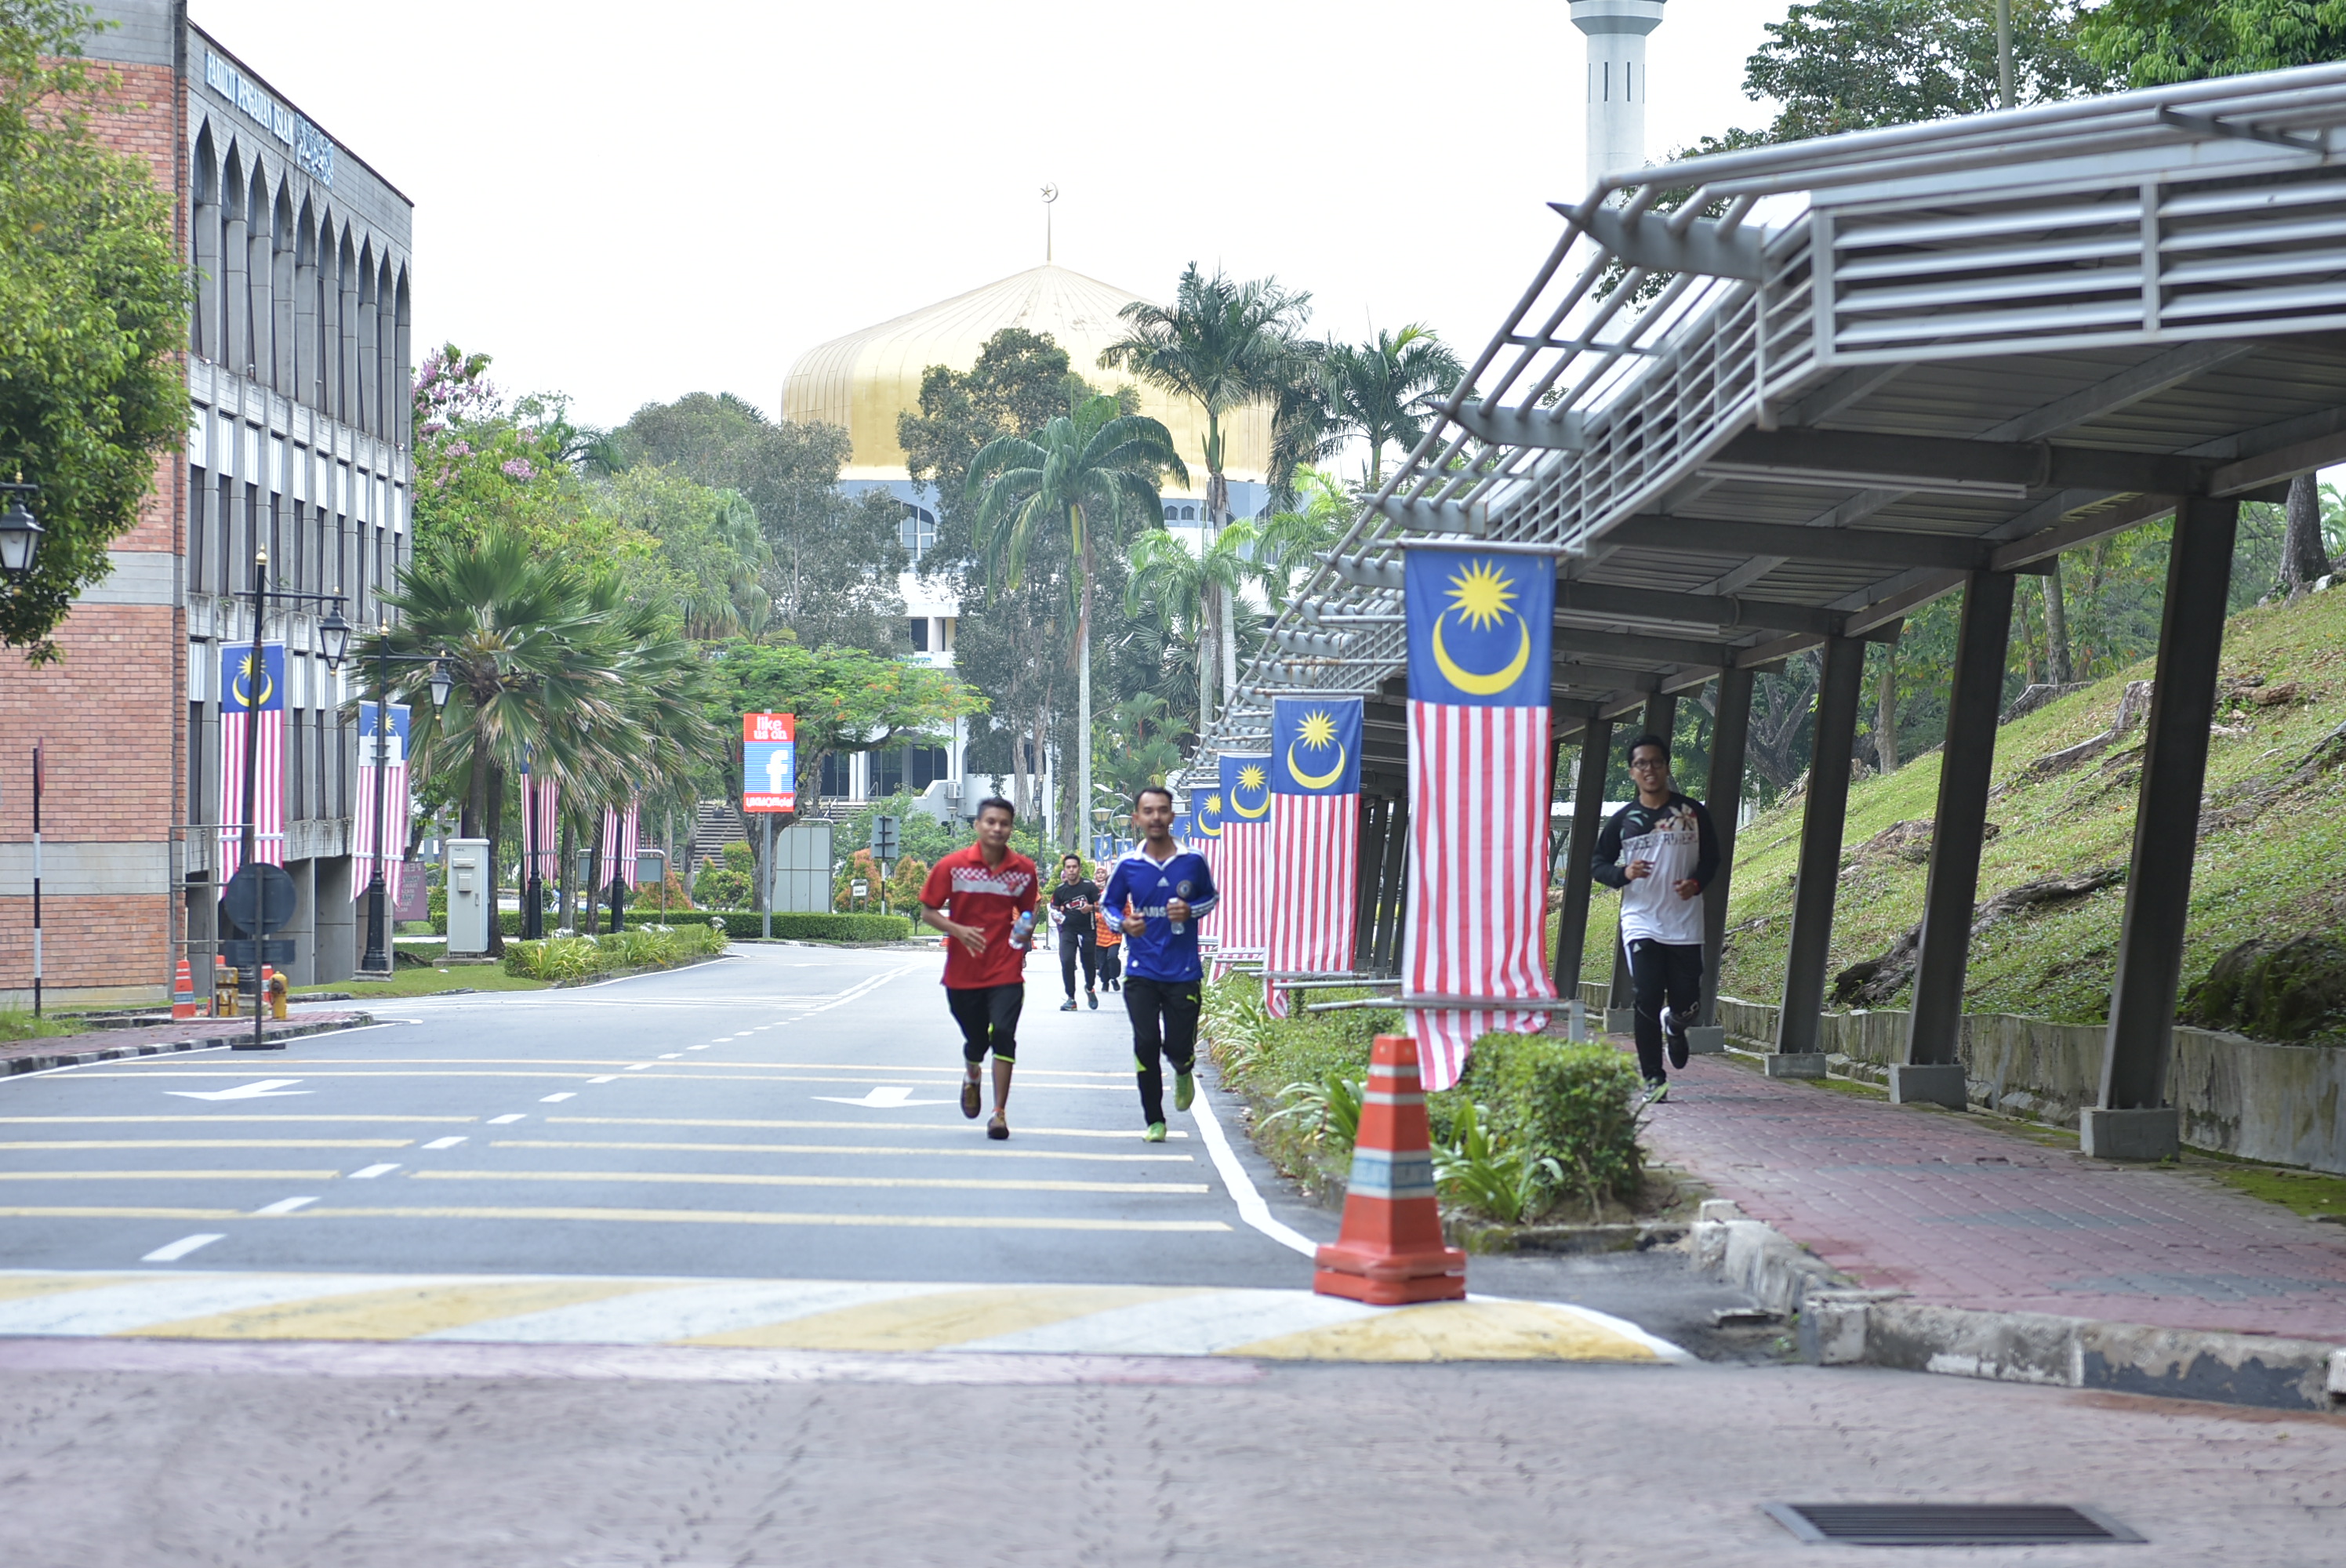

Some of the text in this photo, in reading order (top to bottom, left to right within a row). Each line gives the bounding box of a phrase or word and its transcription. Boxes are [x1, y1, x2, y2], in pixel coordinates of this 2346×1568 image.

[274, 103, 294, 147] ISLAM
[757, 716, 783, 731] like
[754, 730, 788, 740] us on
